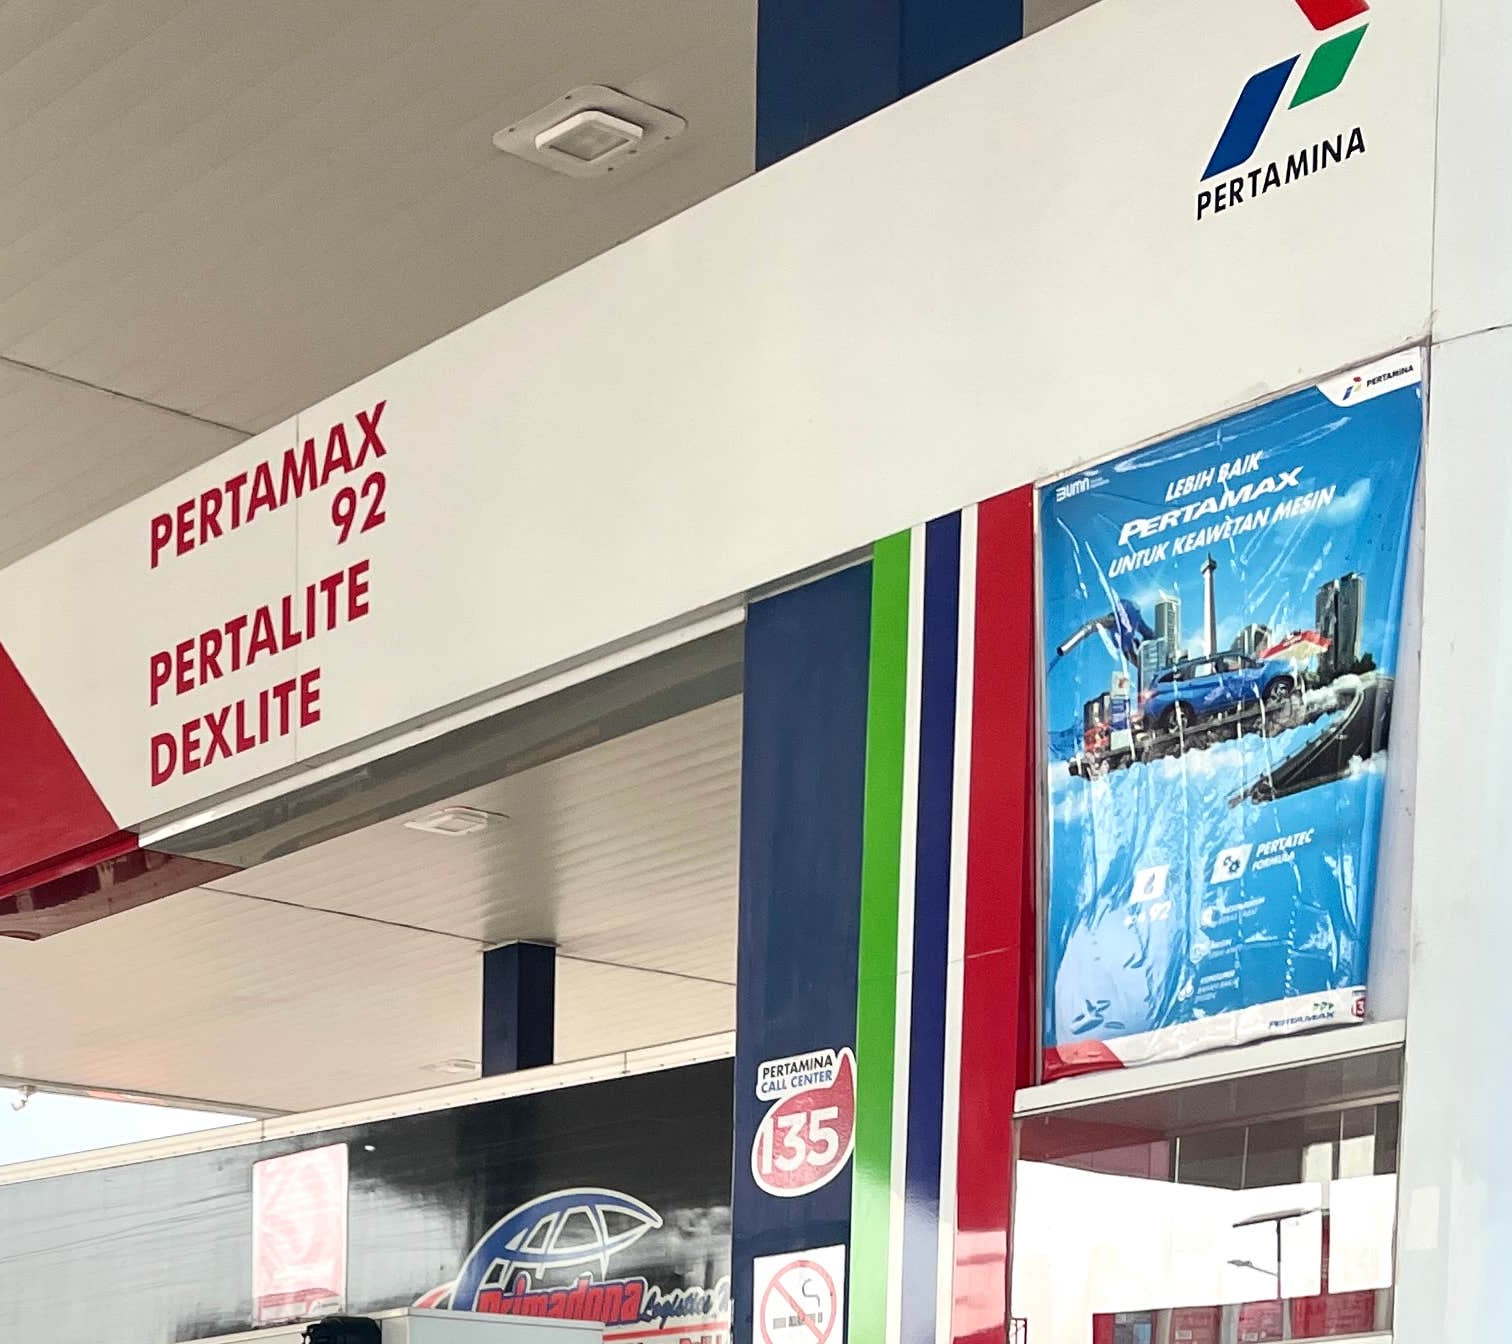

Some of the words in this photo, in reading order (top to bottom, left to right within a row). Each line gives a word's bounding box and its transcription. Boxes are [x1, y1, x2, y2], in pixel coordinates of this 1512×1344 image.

[1196, 126, 1366, 221] PERTAMINA
[150, 399, 387, 569] PERTAMAX
[331, 471, 387, 545] 92
[1118, 465, 1304, 546] PERTAMAX
[1164, 466, 1217, 503] LEBIH
[1217, 449, 1264, 483] BAIK
[1108, 541, 1171, 579] UNTUK
[1171, 507, 1271, 558] KEAWETAN
[1272, 484, 1338, 525] MESIN
[150, 559, 370, 707] PERTALITE
[150, 667, 321, 788] DEXLITE
[1256, 828, 1315, 858] PERTATEC
[761, 1077, 787, 1094] CALL
[791, 1070, 833, 1088] CENTER
[762, 1054, 833, 1079] PERTAMINA
[760, 1105, 839, 1175] 135
